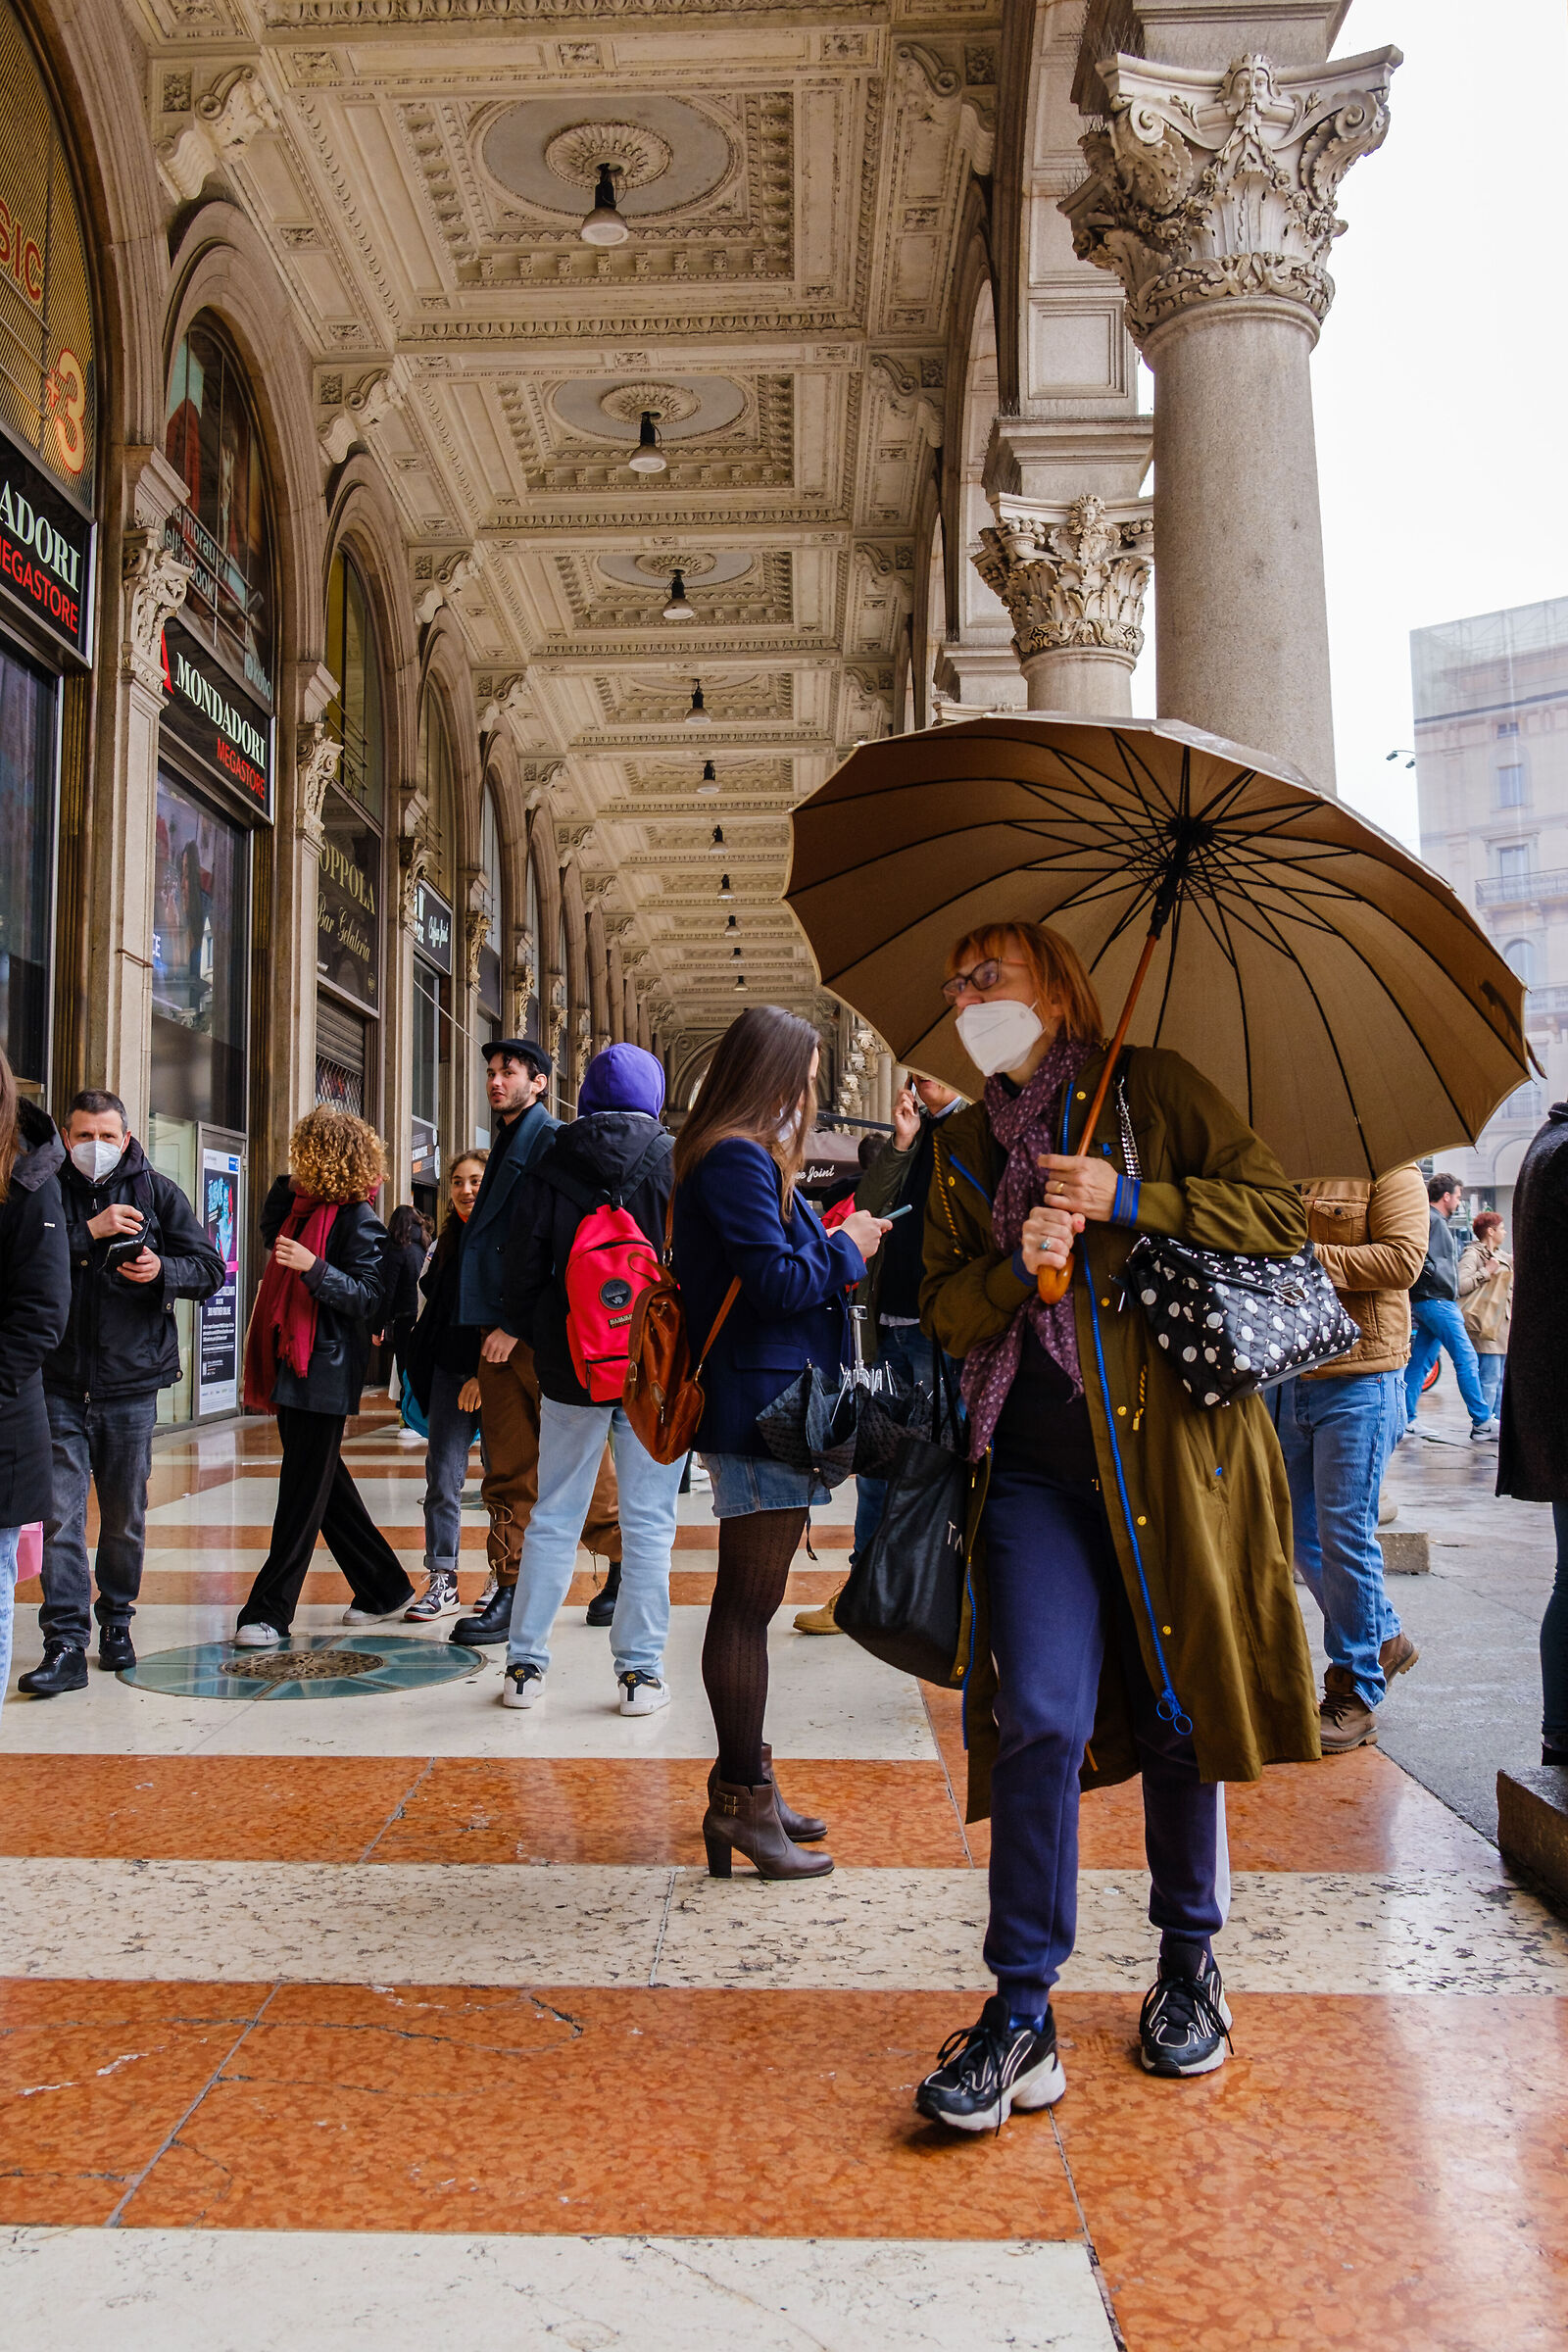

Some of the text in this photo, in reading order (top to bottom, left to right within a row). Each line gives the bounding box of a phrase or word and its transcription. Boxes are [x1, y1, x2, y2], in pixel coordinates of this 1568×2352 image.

[174, 651, 266, 769] MONDADORI
[217, 736, 266, 801] MEGASTORE
[318, 891, 335, 934] Bar
[337, 906, 370, 963] Gelateria
[807, 1164, 835, 1183] Joint
